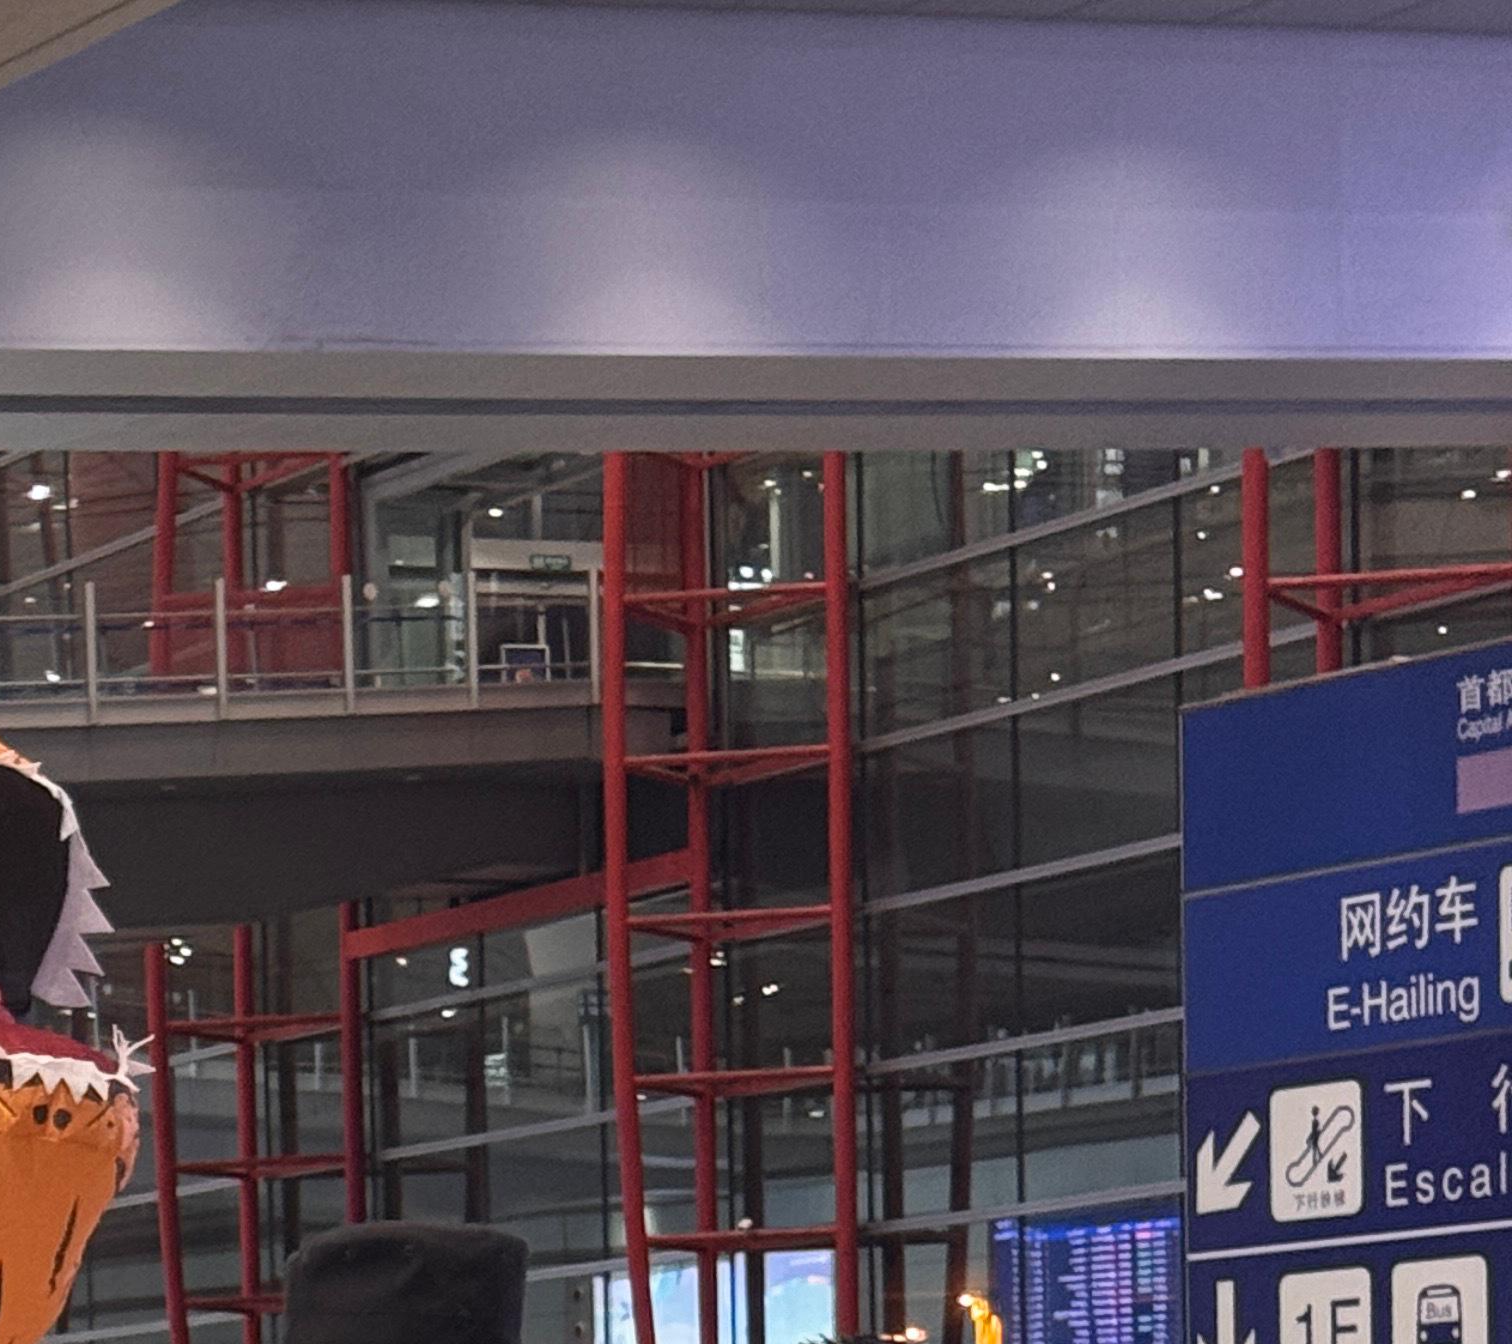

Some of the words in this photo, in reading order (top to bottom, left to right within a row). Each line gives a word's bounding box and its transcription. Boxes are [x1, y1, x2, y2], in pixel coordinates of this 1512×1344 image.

[1341, 876, 1479, 962] 网约车
[1326, 972, 1480, 1031] E-Hailing
[1385, 1150, 1508, 1208] Escal
[1425, 1301, 1453, 1320] Bus
